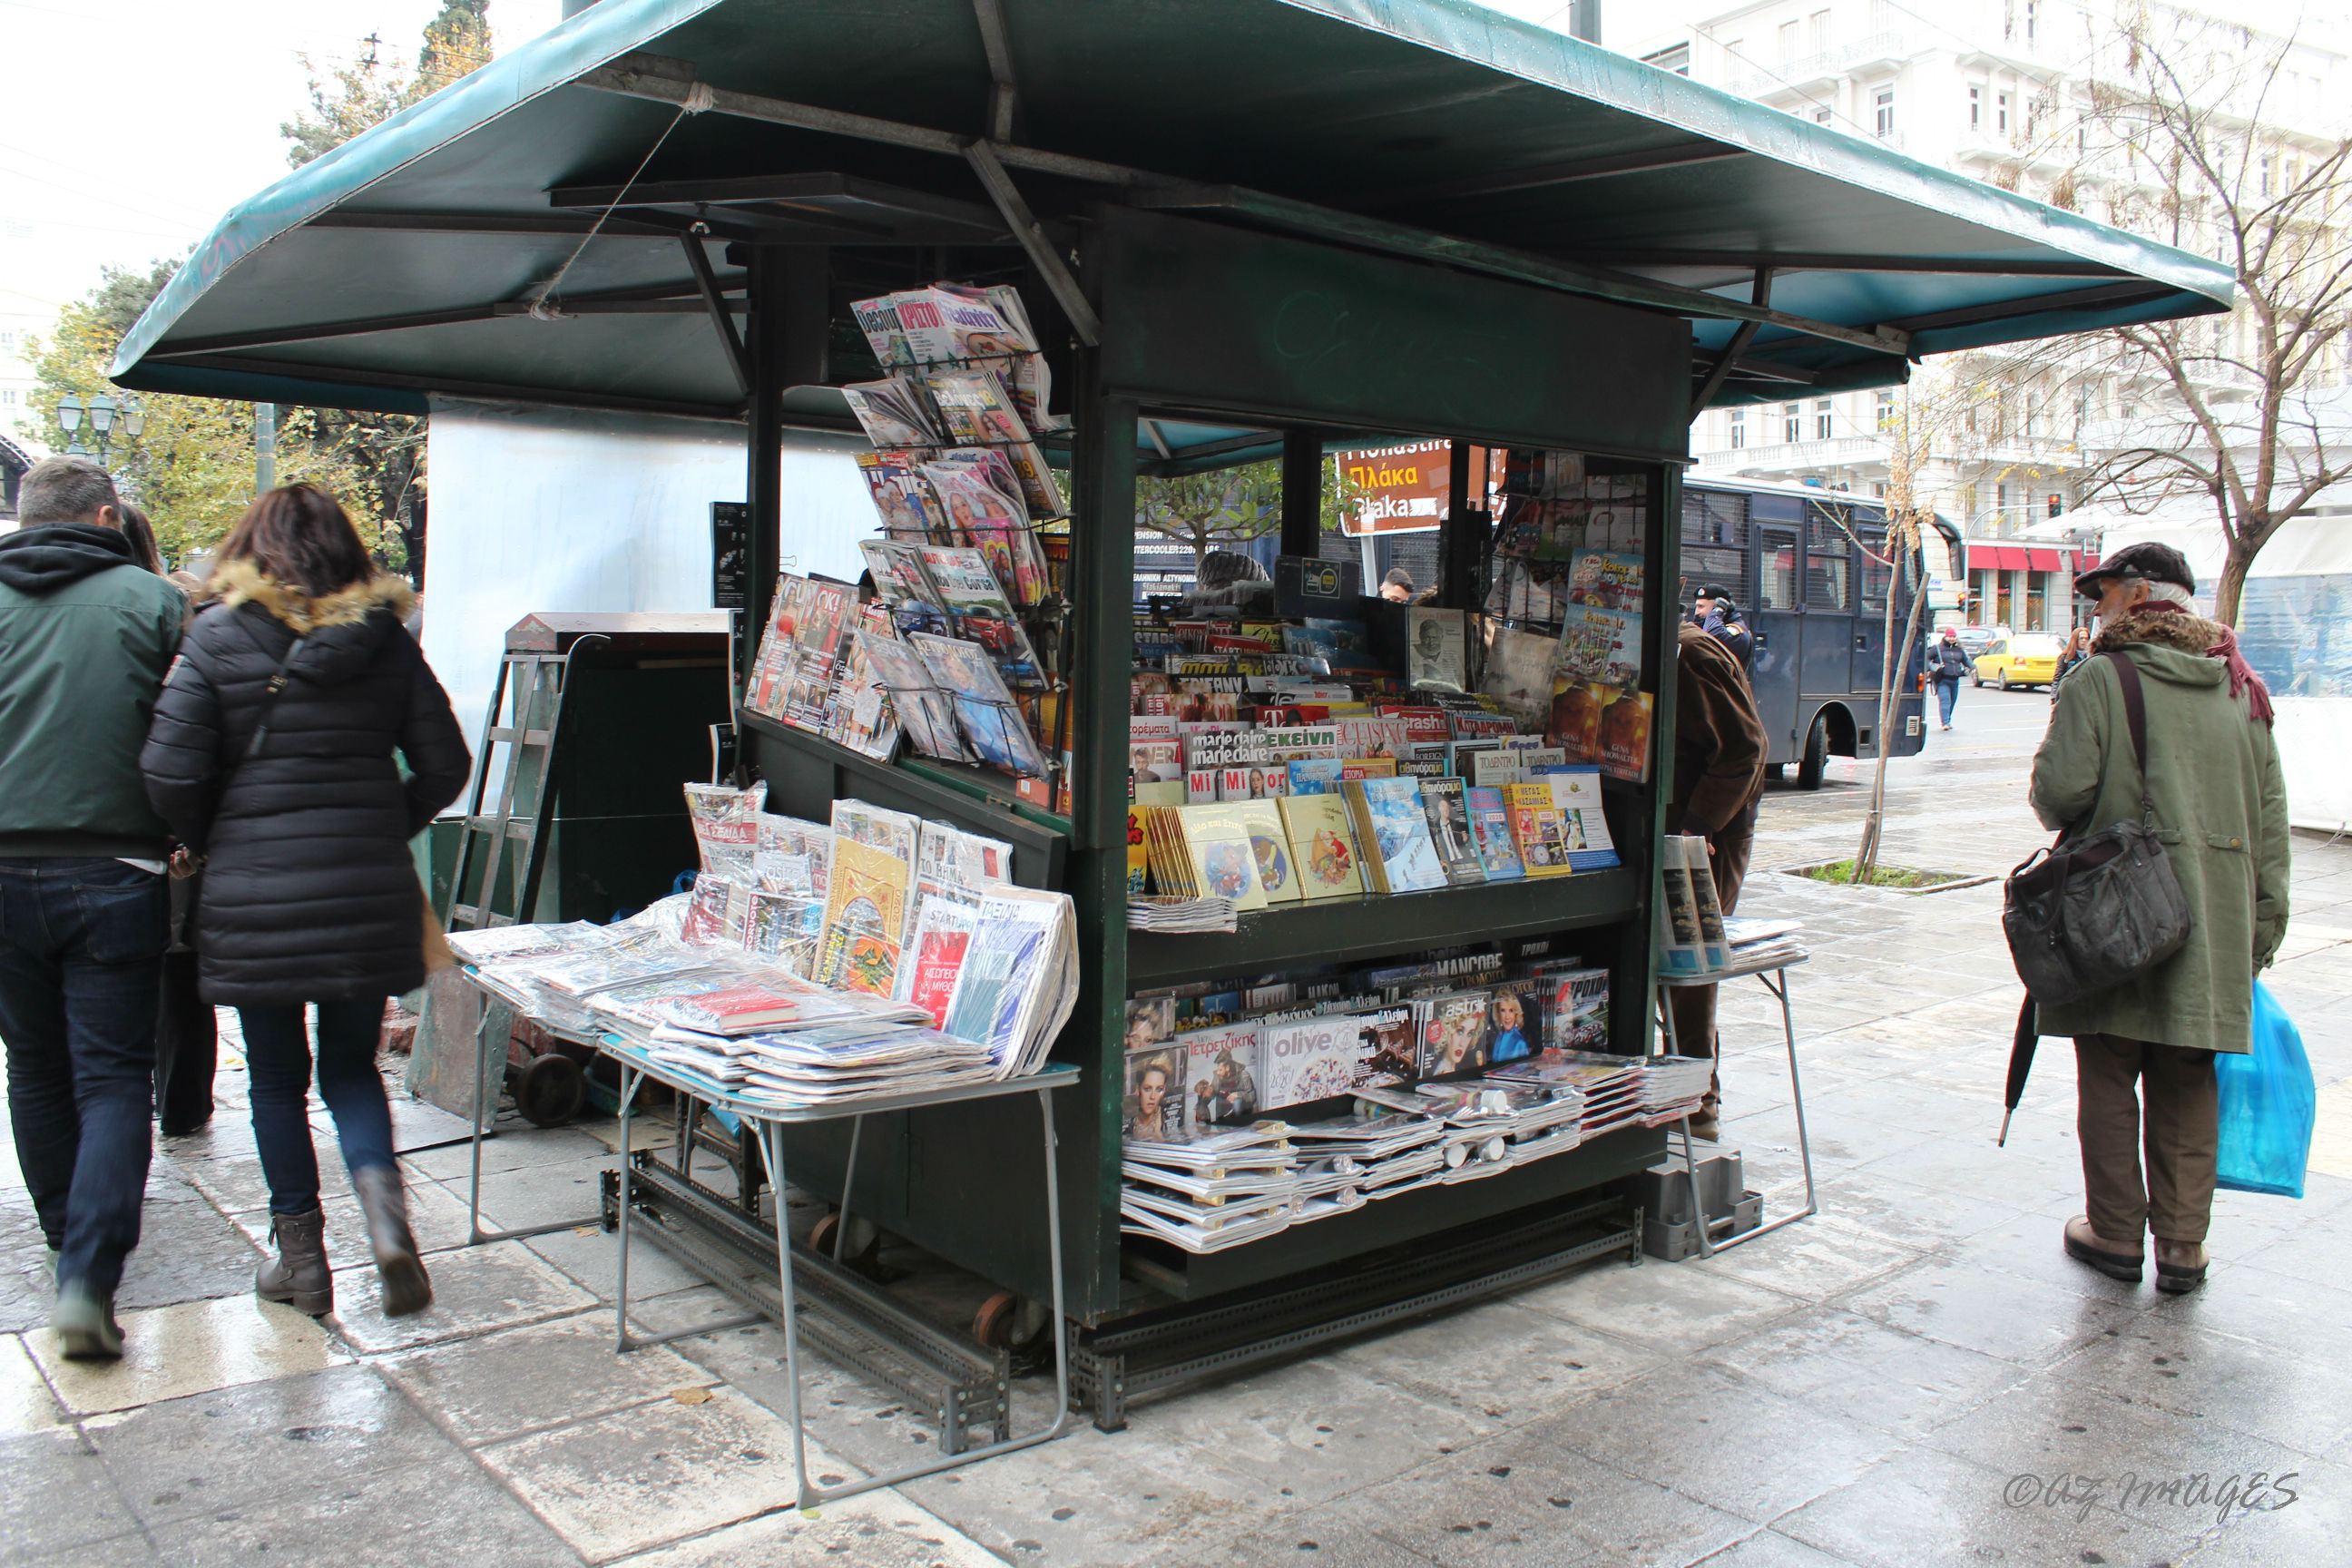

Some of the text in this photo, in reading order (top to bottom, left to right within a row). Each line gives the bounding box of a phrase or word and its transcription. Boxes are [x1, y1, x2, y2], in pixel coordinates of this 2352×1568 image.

[1348, 463, 1418, 490] Πλάκα
[1133, 573, 1197, 583] ΕΛΛΗΝΙΚΗ ΑΣΤΥΝΟΜΙΑ
[818, 590, 842, 612] OK!
[1192, 730, 1232, 746] marie
[1233, 729, 1267, 745] claire
[1191, 743, 1269, 765] marie claire
[1399, 761, 1444, 776] αθηνόραμα
[920, 858, 964, 885] ΤΟ ΒΗΜΑ
[1184, 1032, 1256, 1058] Πετρετζίκης
[1274, 1032, 1332, 1057] olive
